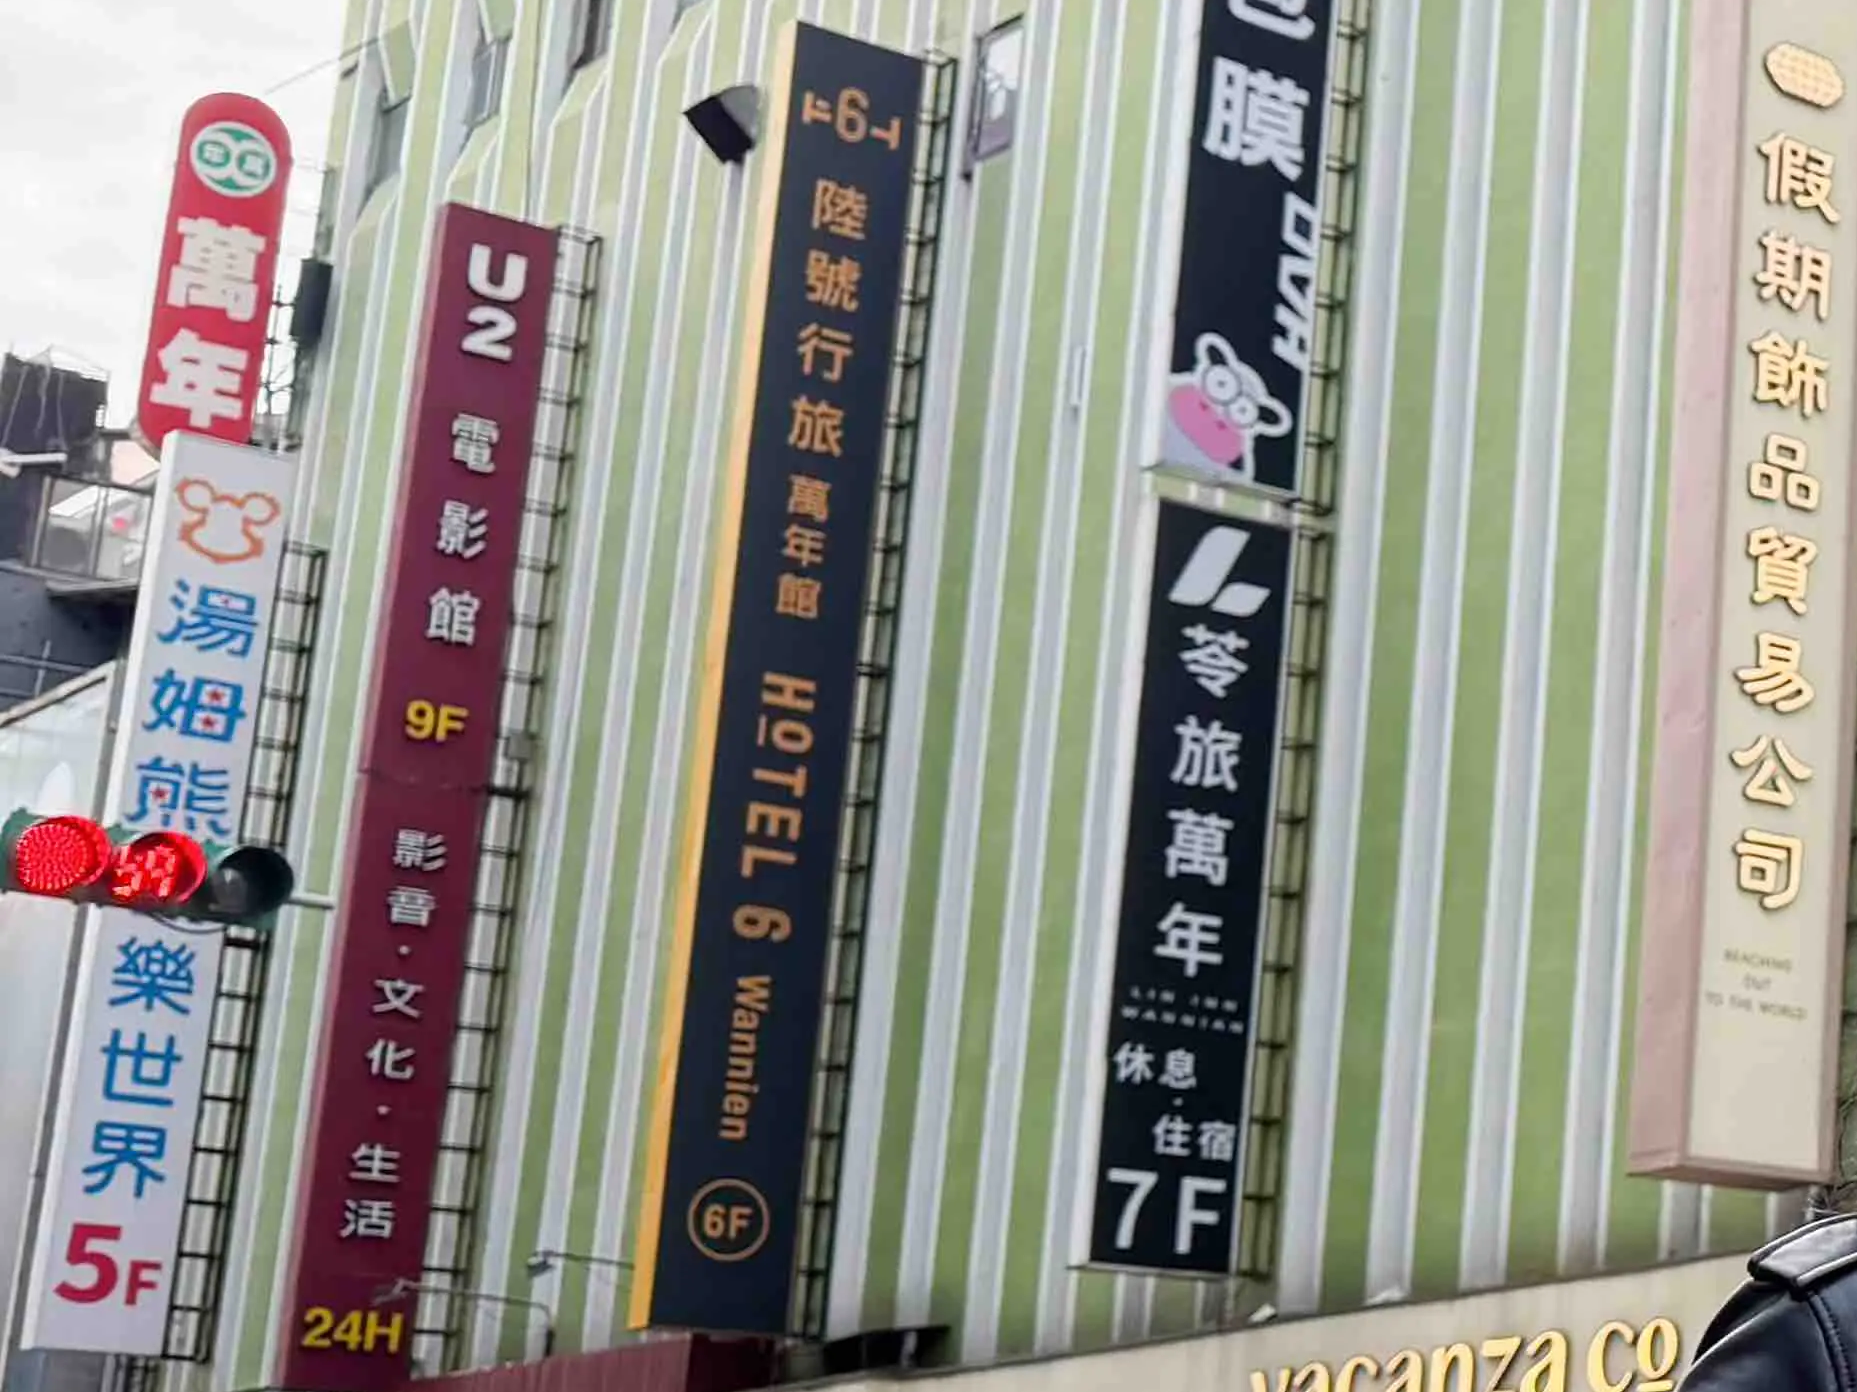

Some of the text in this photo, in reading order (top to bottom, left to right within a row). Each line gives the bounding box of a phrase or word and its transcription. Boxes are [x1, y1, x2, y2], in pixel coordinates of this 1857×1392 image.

[150, 215, 267, 432] 萬年
[461, 243, 529, 363] U2
[425, 412, 499, 647] 電影館
[1732, 129, 1841, 913] 假期飾品貿易公司
[404, 699, 469, 743] 9F
[82, 579, 260, 1201] 湯姆熊樂世界
[718, 670, 817, 1143] HOTEL 6 Wannien
[53, 1222, 163, 1307] 5F
[702, 1203, 753, 1242] 6F
[1106, 1167, 1228, 1257] 7F
[301, 1307, 402, 1355] 24H
